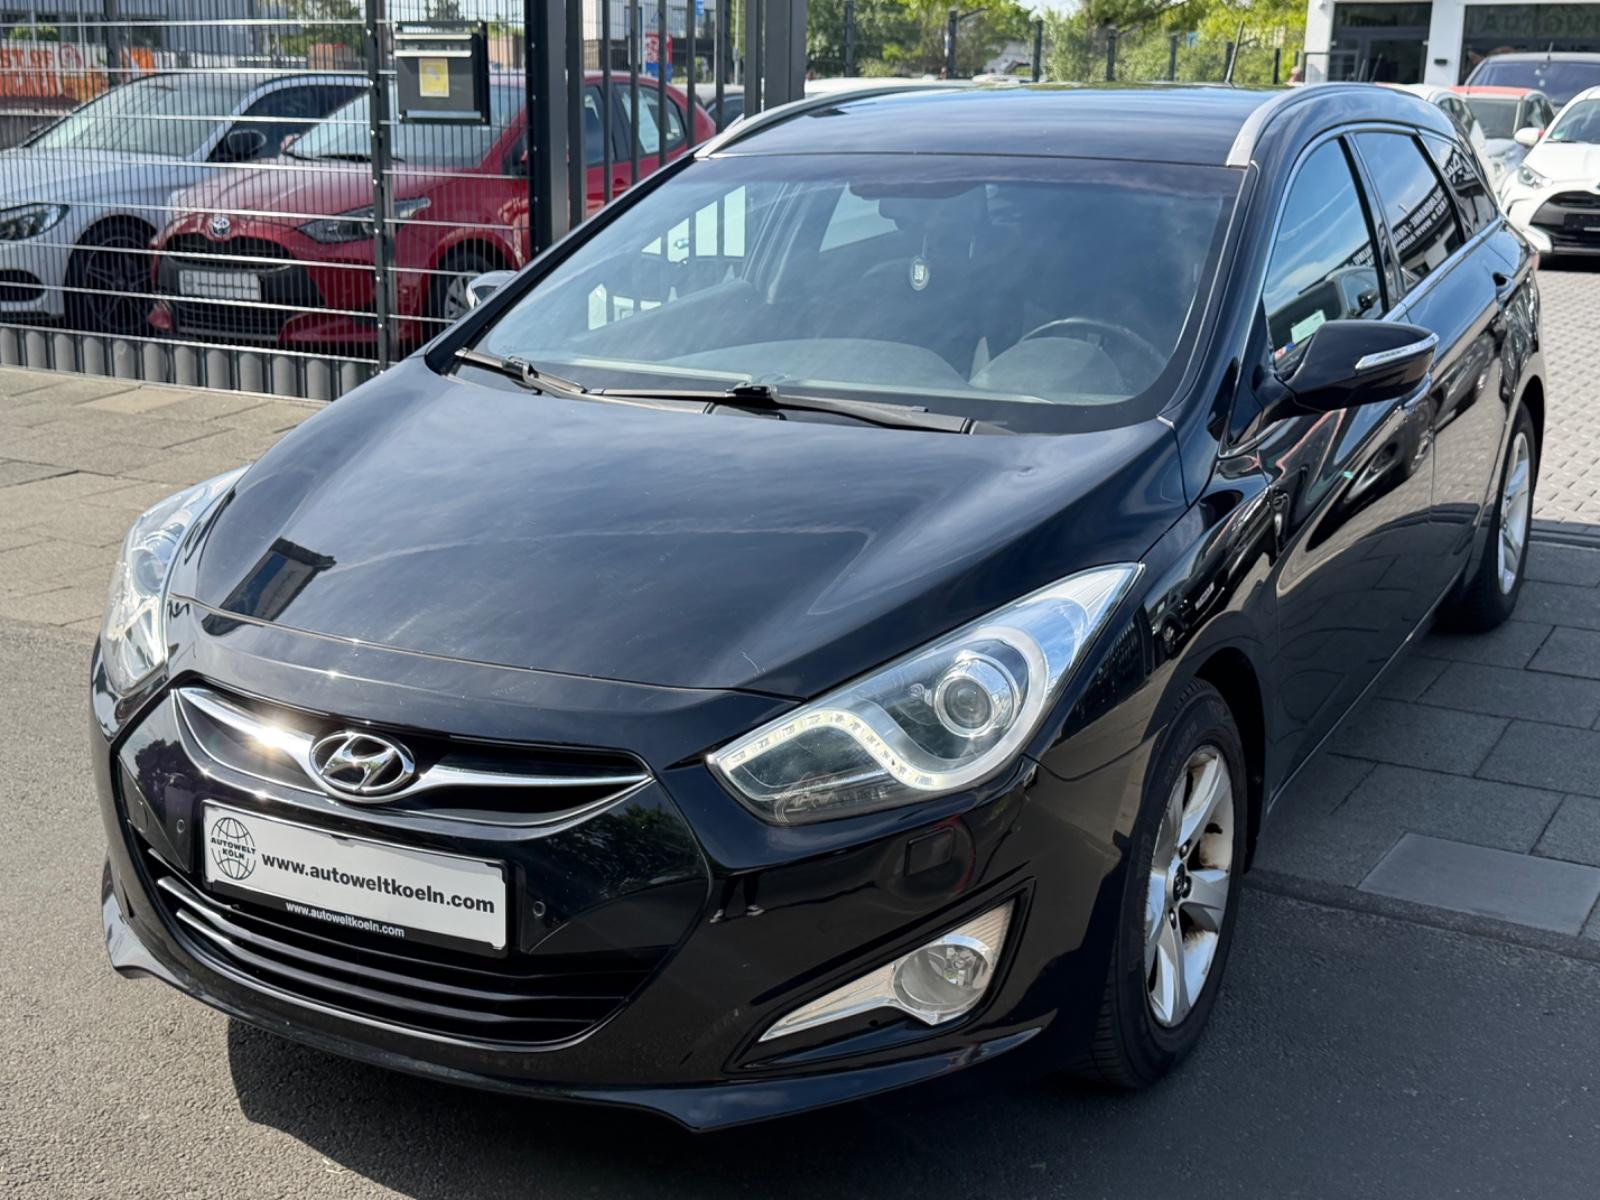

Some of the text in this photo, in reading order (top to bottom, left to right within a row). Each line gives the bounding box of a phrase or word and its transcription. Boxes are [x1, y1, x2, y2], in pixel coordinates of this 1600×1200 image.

[211, 837, 256, 855] AUTOWELT
[262, 853, 495, 914] www.autoweltkoeln.com
[285, 900, 406, 938] www.autoweltkoeln.com
